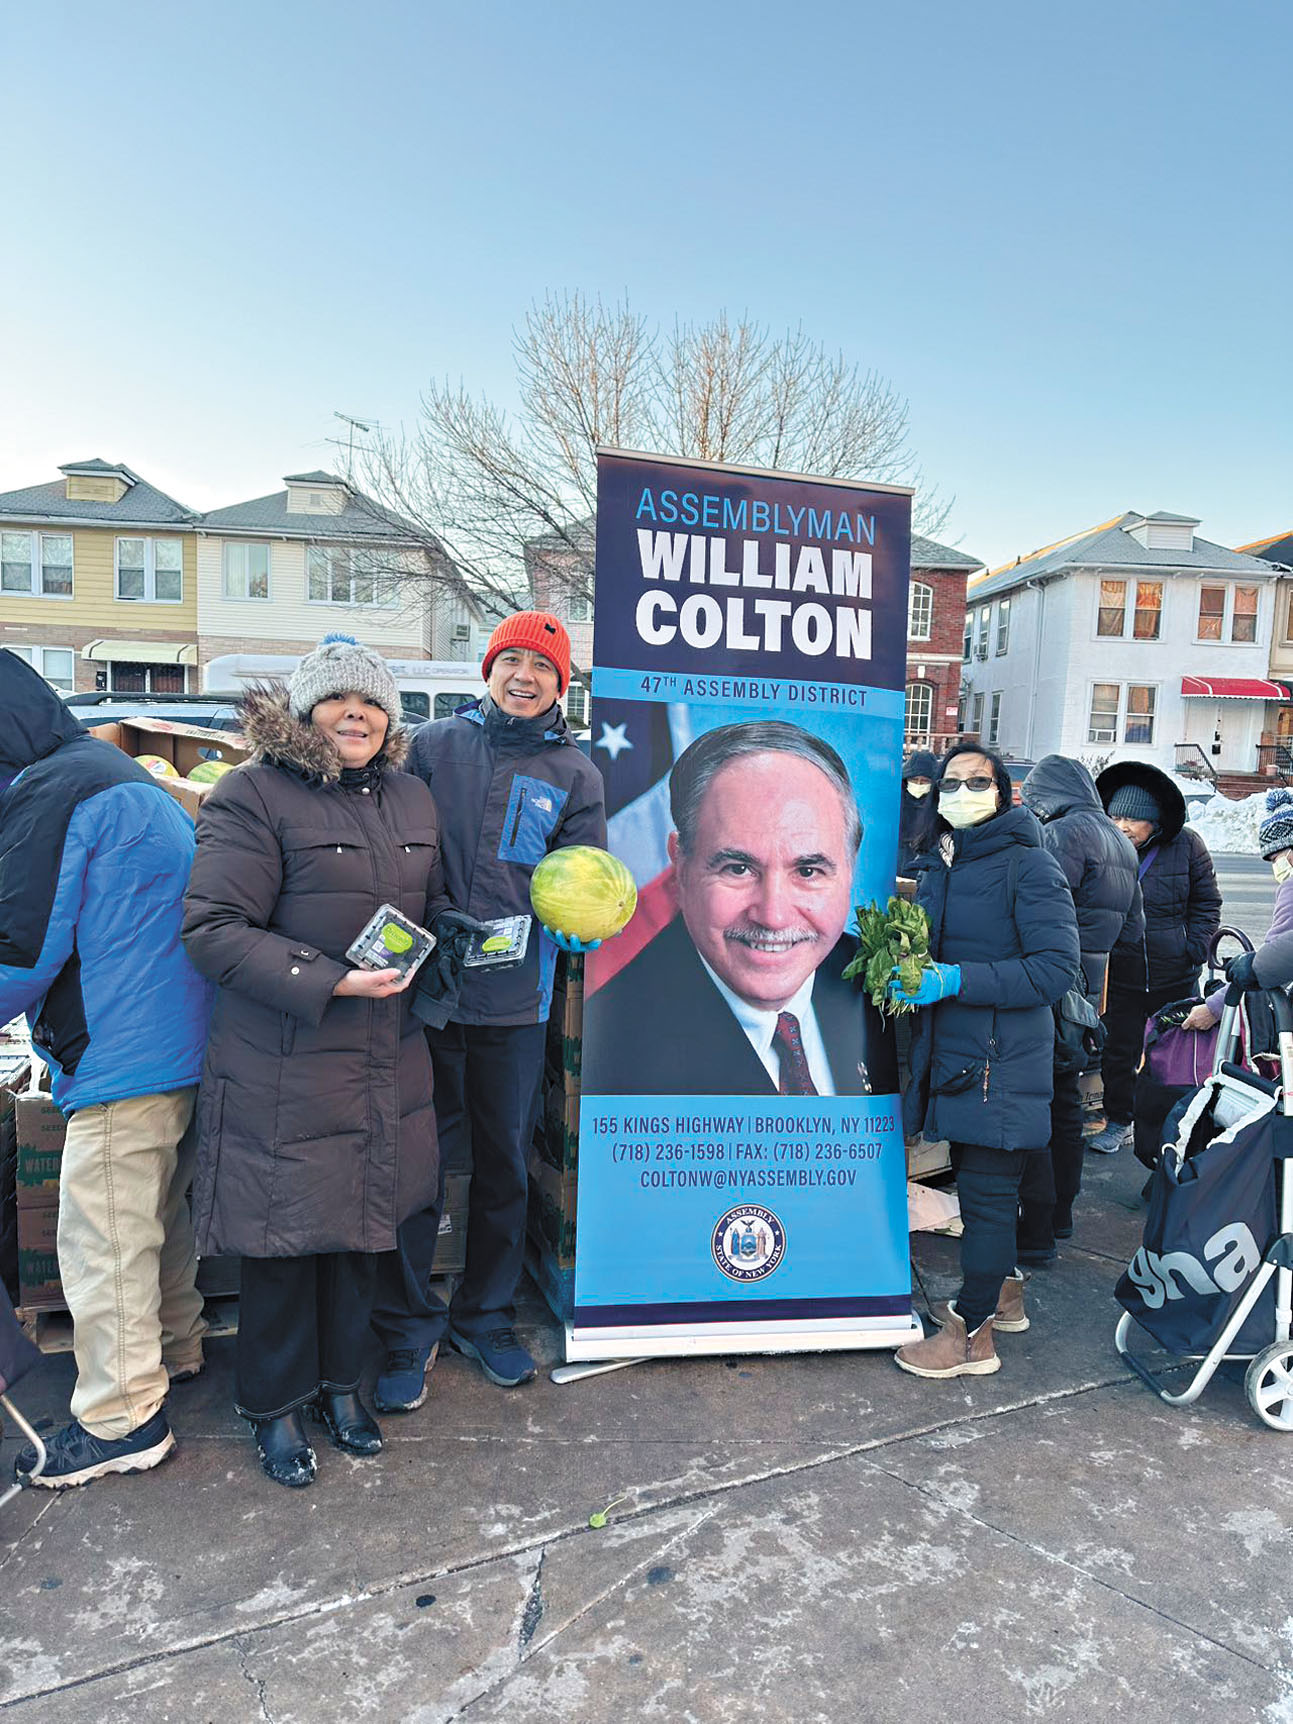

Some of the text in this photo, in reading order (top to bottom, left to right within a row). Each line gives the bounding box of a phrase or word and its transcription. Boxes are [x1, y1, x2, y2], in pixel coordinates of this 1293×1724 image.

[636, 487, 877, 546] ASSEMBLYMAN
[636, 528, 873, 600] WILLIAM
[636, 589, 873, 661] COLTON
[640, 676, 868, 707] 47TH ASSEMBLY DISTRICT
[593, 1116, 618, 1134] 155
[624, 1116, 670, 1134] KINGS
[675, 1116, 745, 1134] HIGHWAY
[755, 1116, 836, 1136] BROOKLYN,
[841, 1116, 860, 1134] NY
[865, 1115, 896, 1133] 11223
[612, 1142, 650, 1163] (718)
[655, 1143, 725, 1161] 236-1598
[736, 1143, 768, 1160] FAX:
[773, 1141, 810, 1161] (718)
[815, 1143, 883, 1160] 236-6507
[640, 1169, 857, 1189] COLTONW@NYASSEMBLY.GOV
[726, 1208, 775, 1224] ASSEMBLY
[715, 1244, 782, 1278] STATE OF NEW YORK
